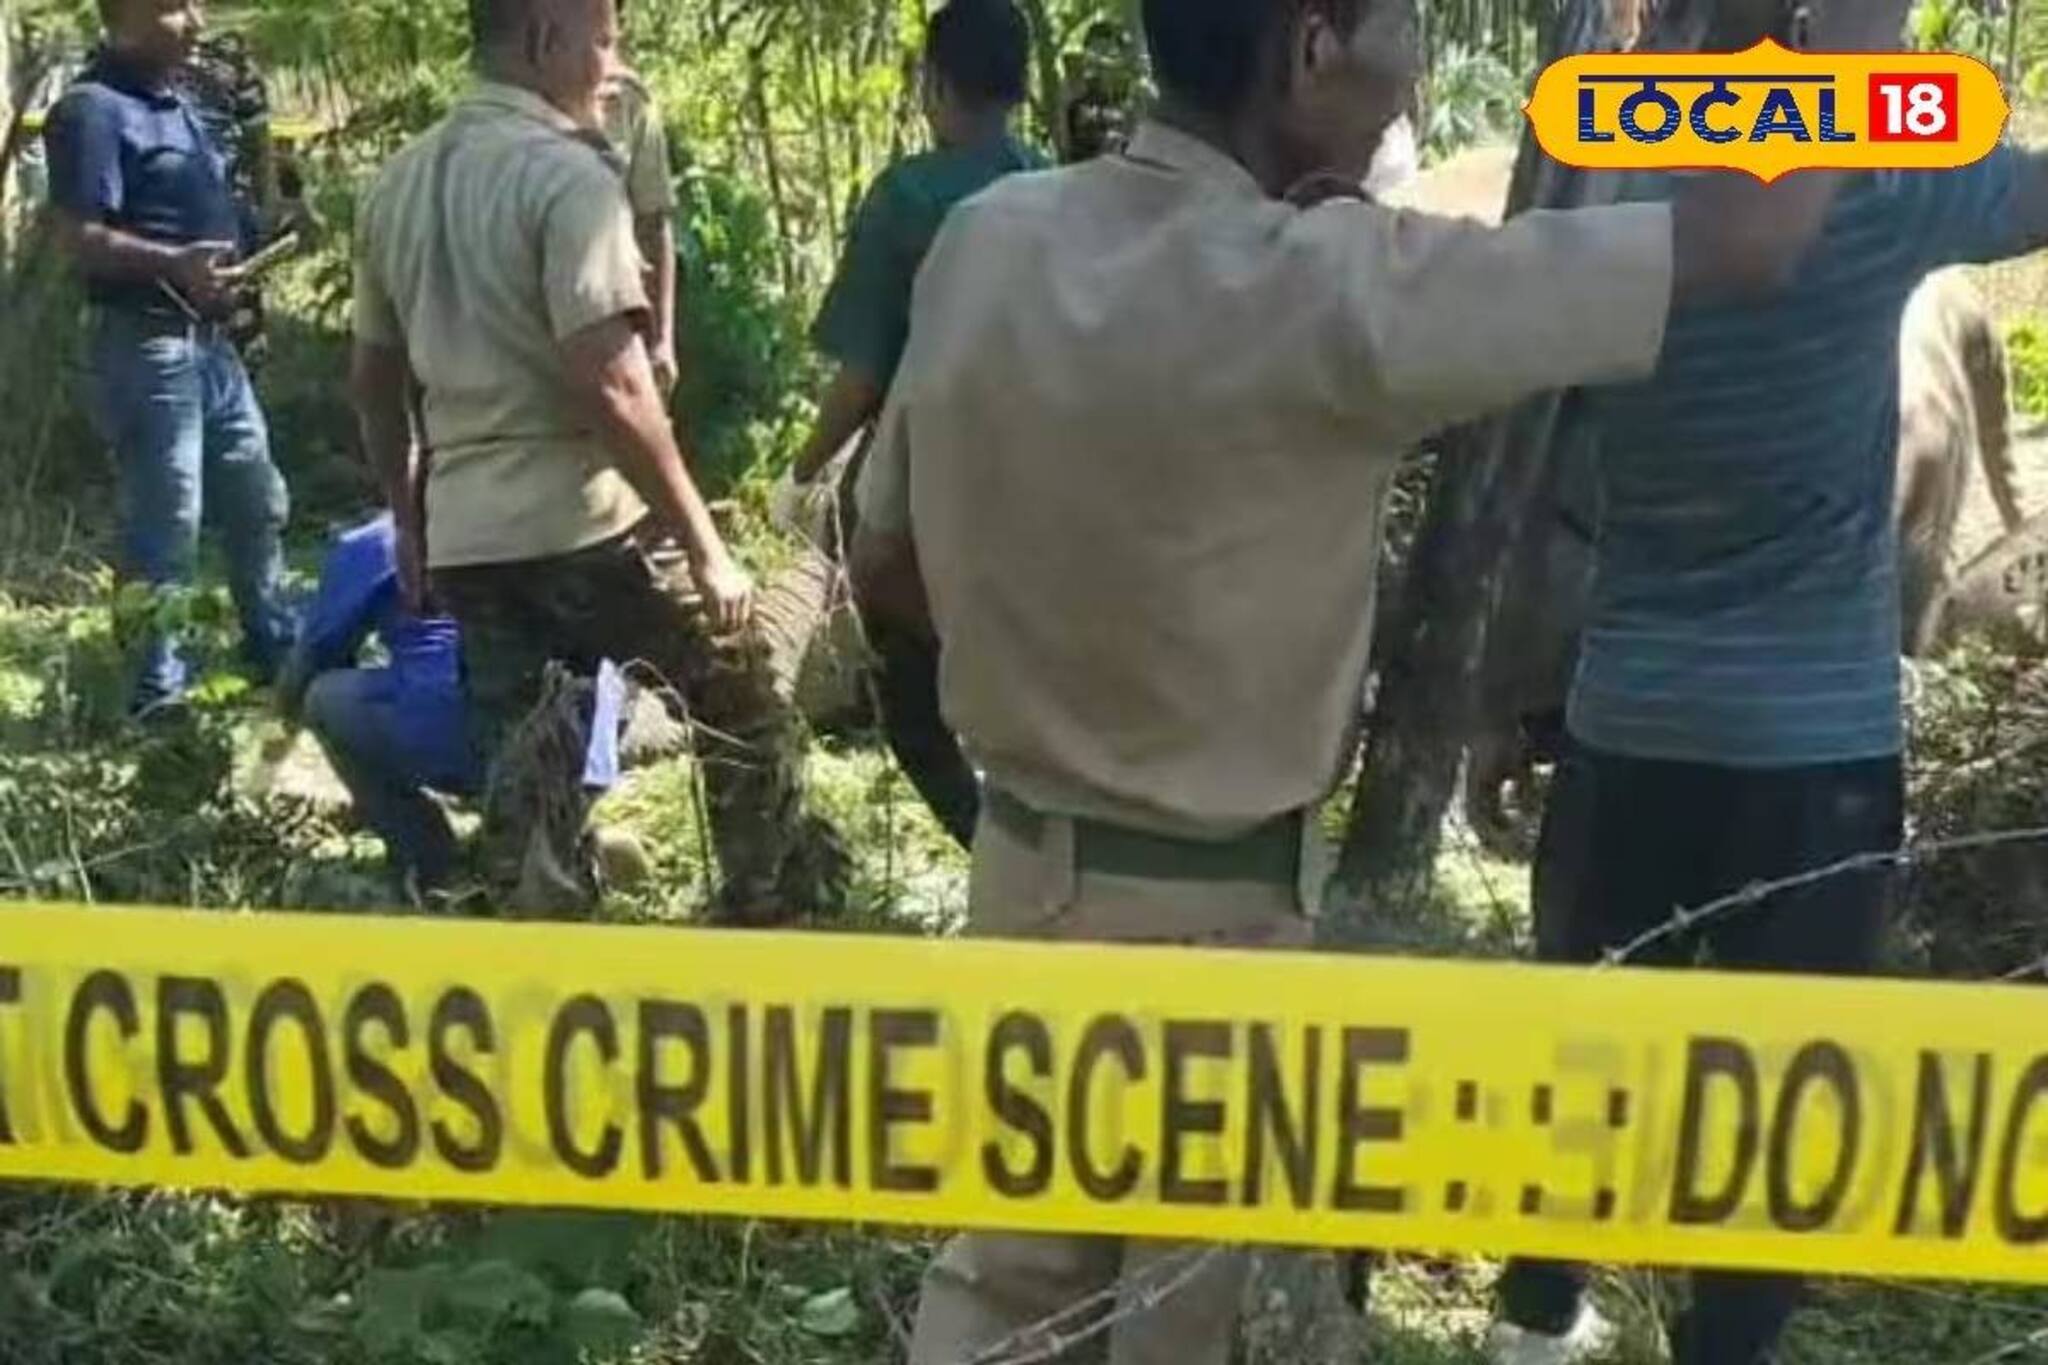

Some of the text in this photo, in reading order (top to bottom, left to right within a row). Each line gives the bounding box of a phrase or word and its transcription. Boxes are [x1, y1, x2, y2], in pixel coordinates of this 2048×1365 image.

[64, 969, 502, 1173] CROSS
[543, 993, 939, 1194] CRIME
[981, 1008, 1410, 1213] SCENE
[1669, 1036, 1861, 1233] DO
